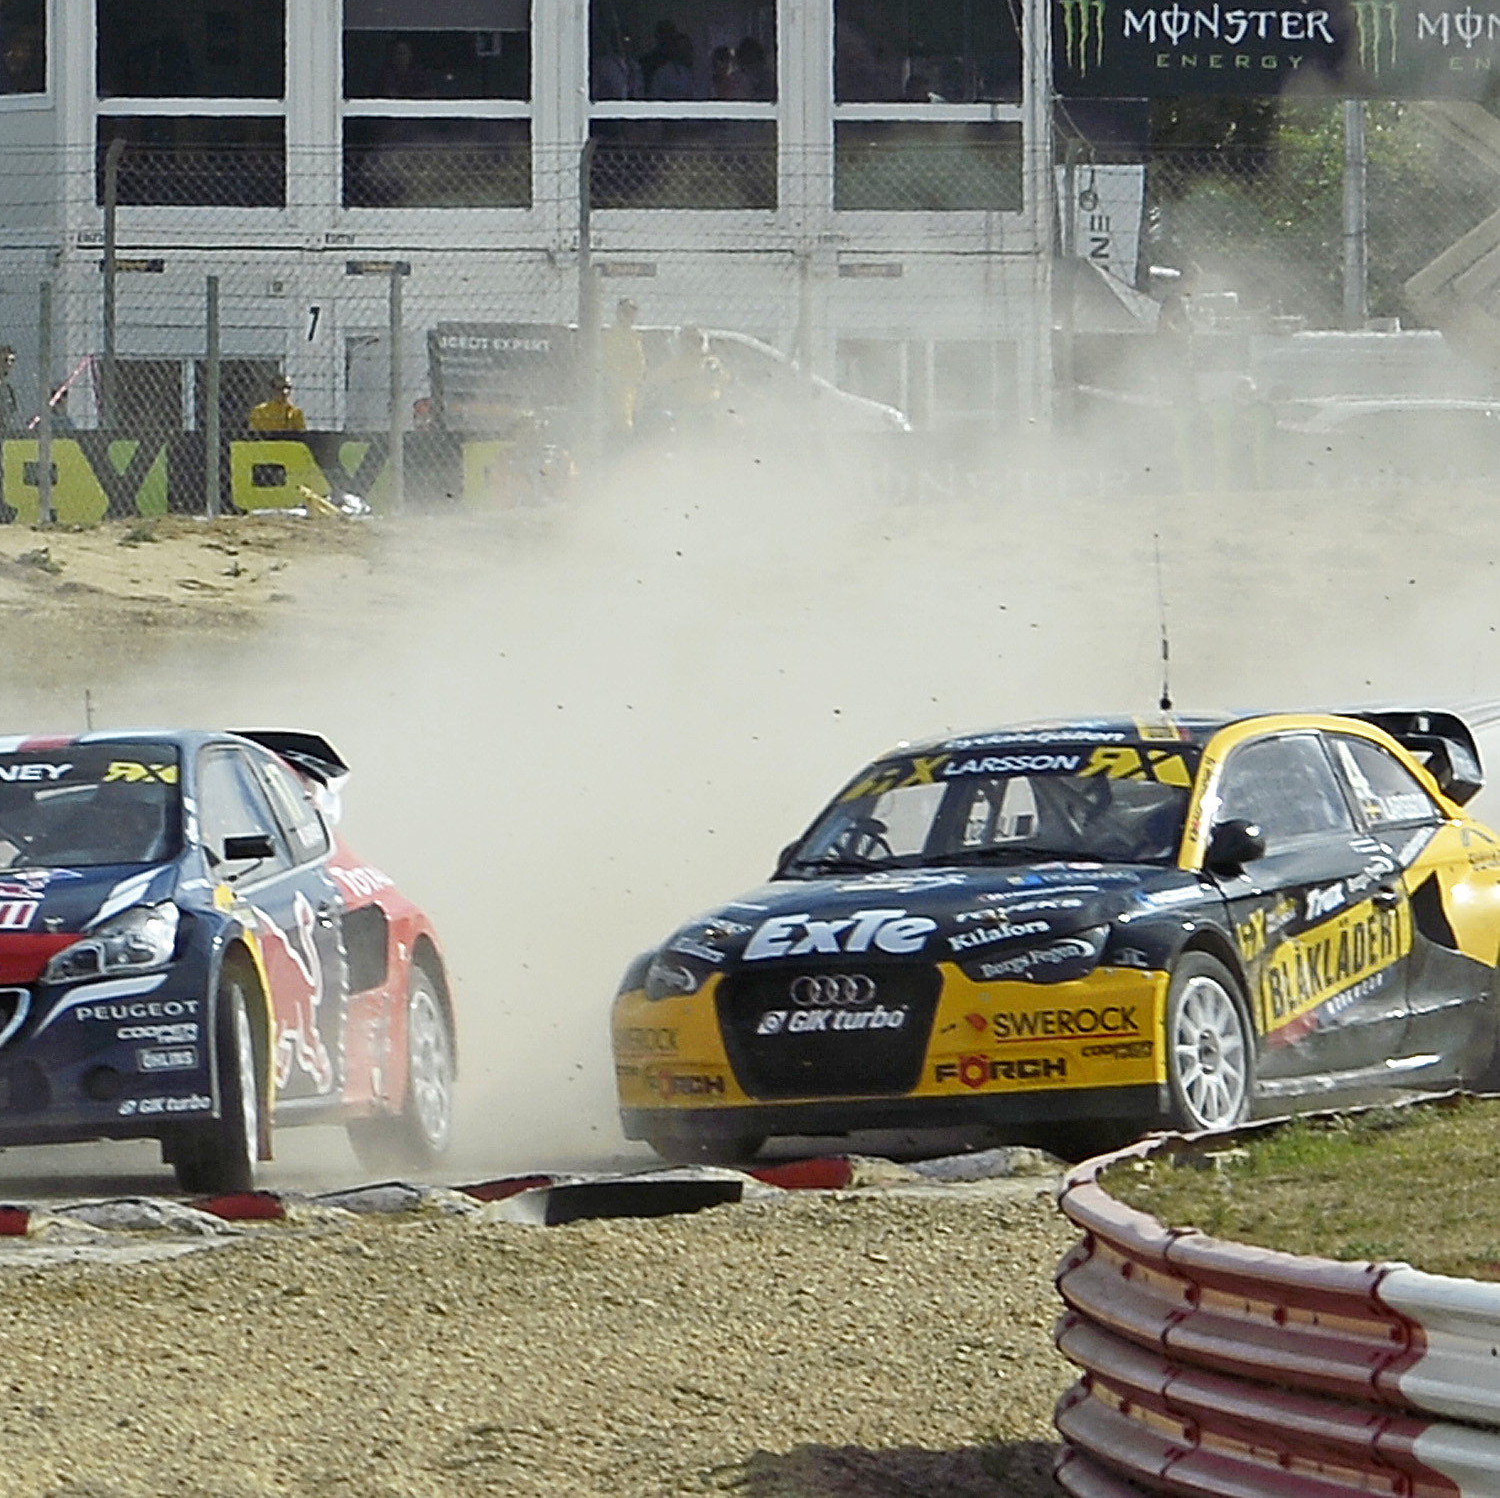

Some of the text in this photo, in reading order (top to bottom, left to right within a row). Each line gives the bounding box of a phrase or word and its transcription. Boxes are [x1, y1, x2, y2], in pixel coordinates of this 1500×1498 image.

[1123, 3, 1335, 45] MONSTER
[1156, 54, 1305, 69] ENERGY
[942, 754, 1081, 776] LARSSON
[742, 909, 938, 961] ExTe
[75, 999, 199, 1021] PEUGEOT
[834, 1005, 906, 1031] turbo
[993, 1006, 1139, 1038] SWEROCK
